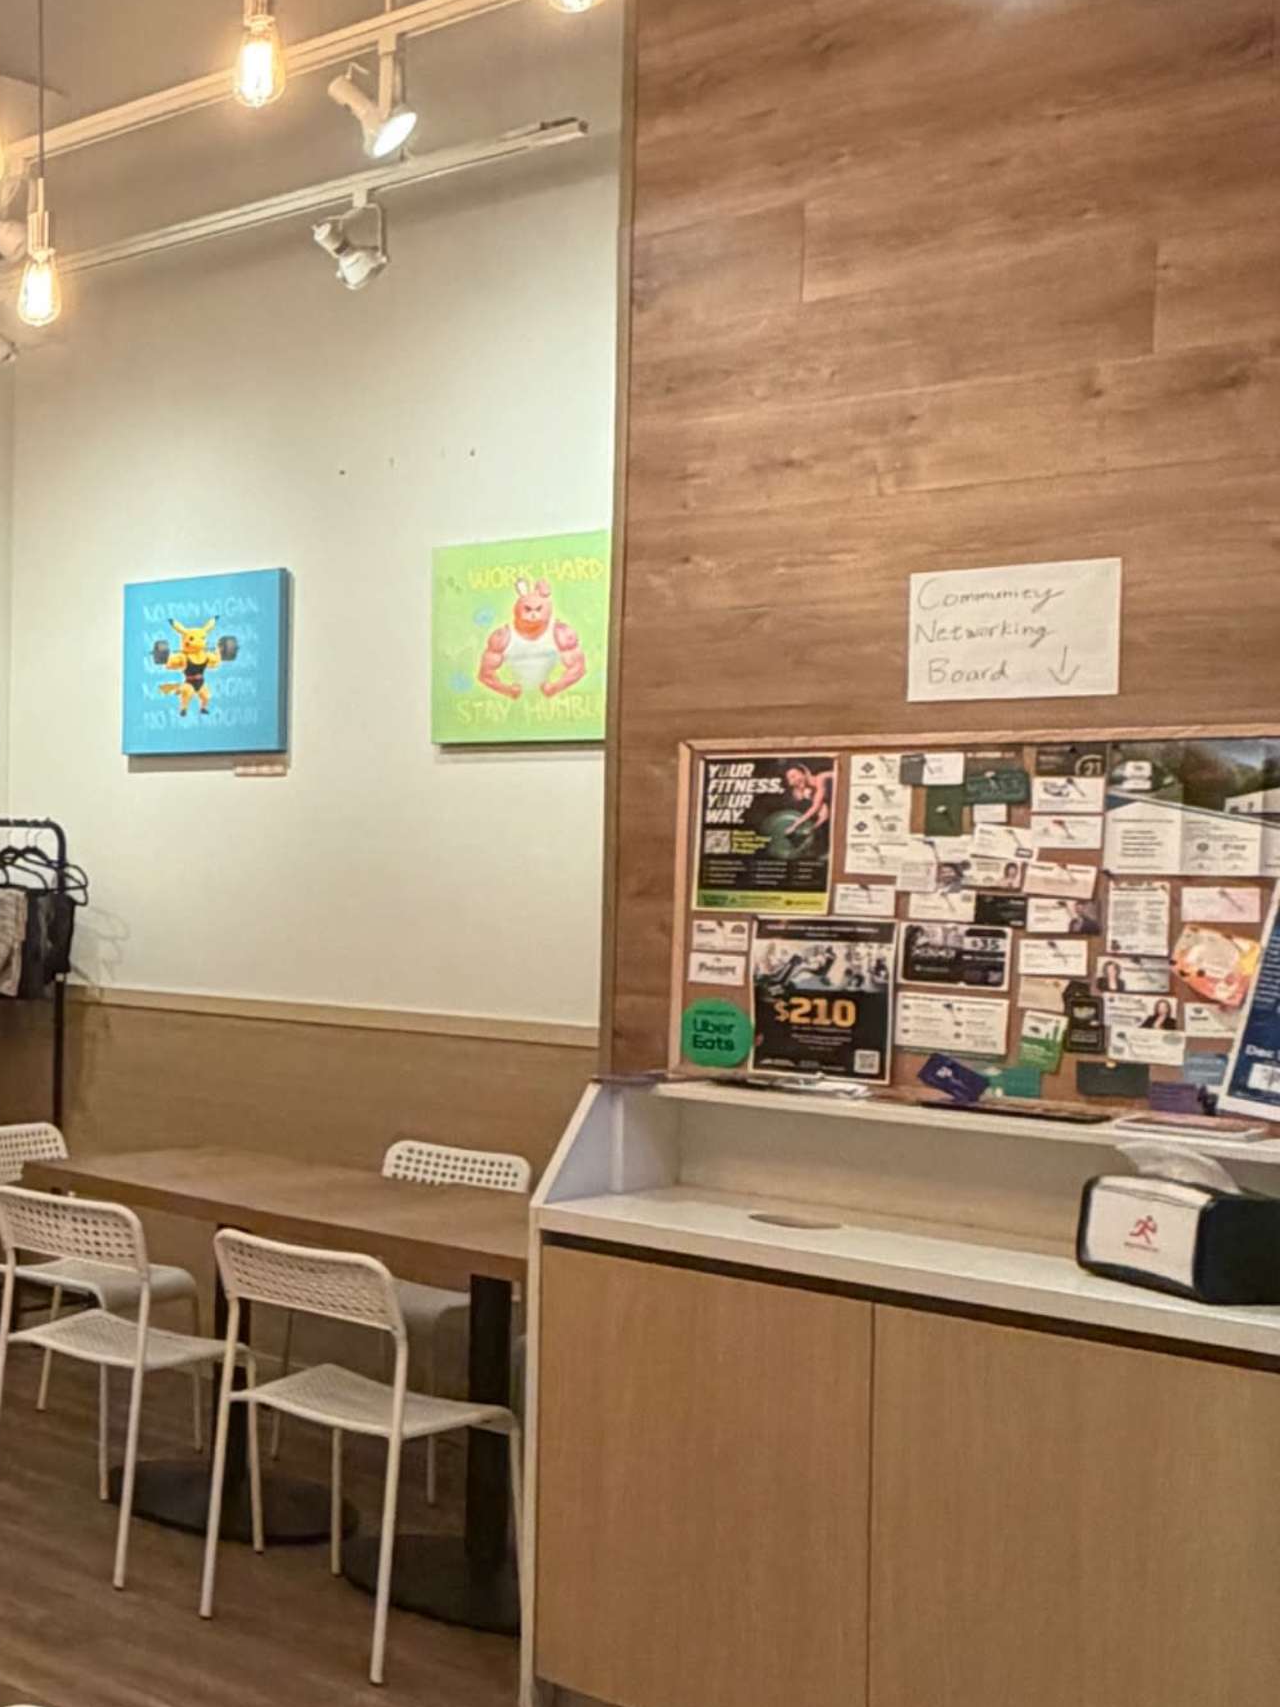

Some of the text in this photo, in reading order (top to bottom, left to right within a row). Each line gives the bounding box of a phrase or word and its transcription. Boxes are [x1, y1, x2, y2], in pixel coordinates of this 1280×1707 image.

[468, 557, 603, 589] WORK HARD
[917, 577, 1065, 614] Community
[914, 619, 1056, 648] Networking
[928, 657, 1008, 684] Board
[456, 698, 512, 726] STAY
[707, 763, 755, 778] YOUR
[706, 794, 754, 809] YOUR
[704, 809, 744, 824] WAY.
[774, 997, 857, 1028] $210
[692, 1018, 735, 1035] Uber
[692, 1034, 735, 1052] Eats
